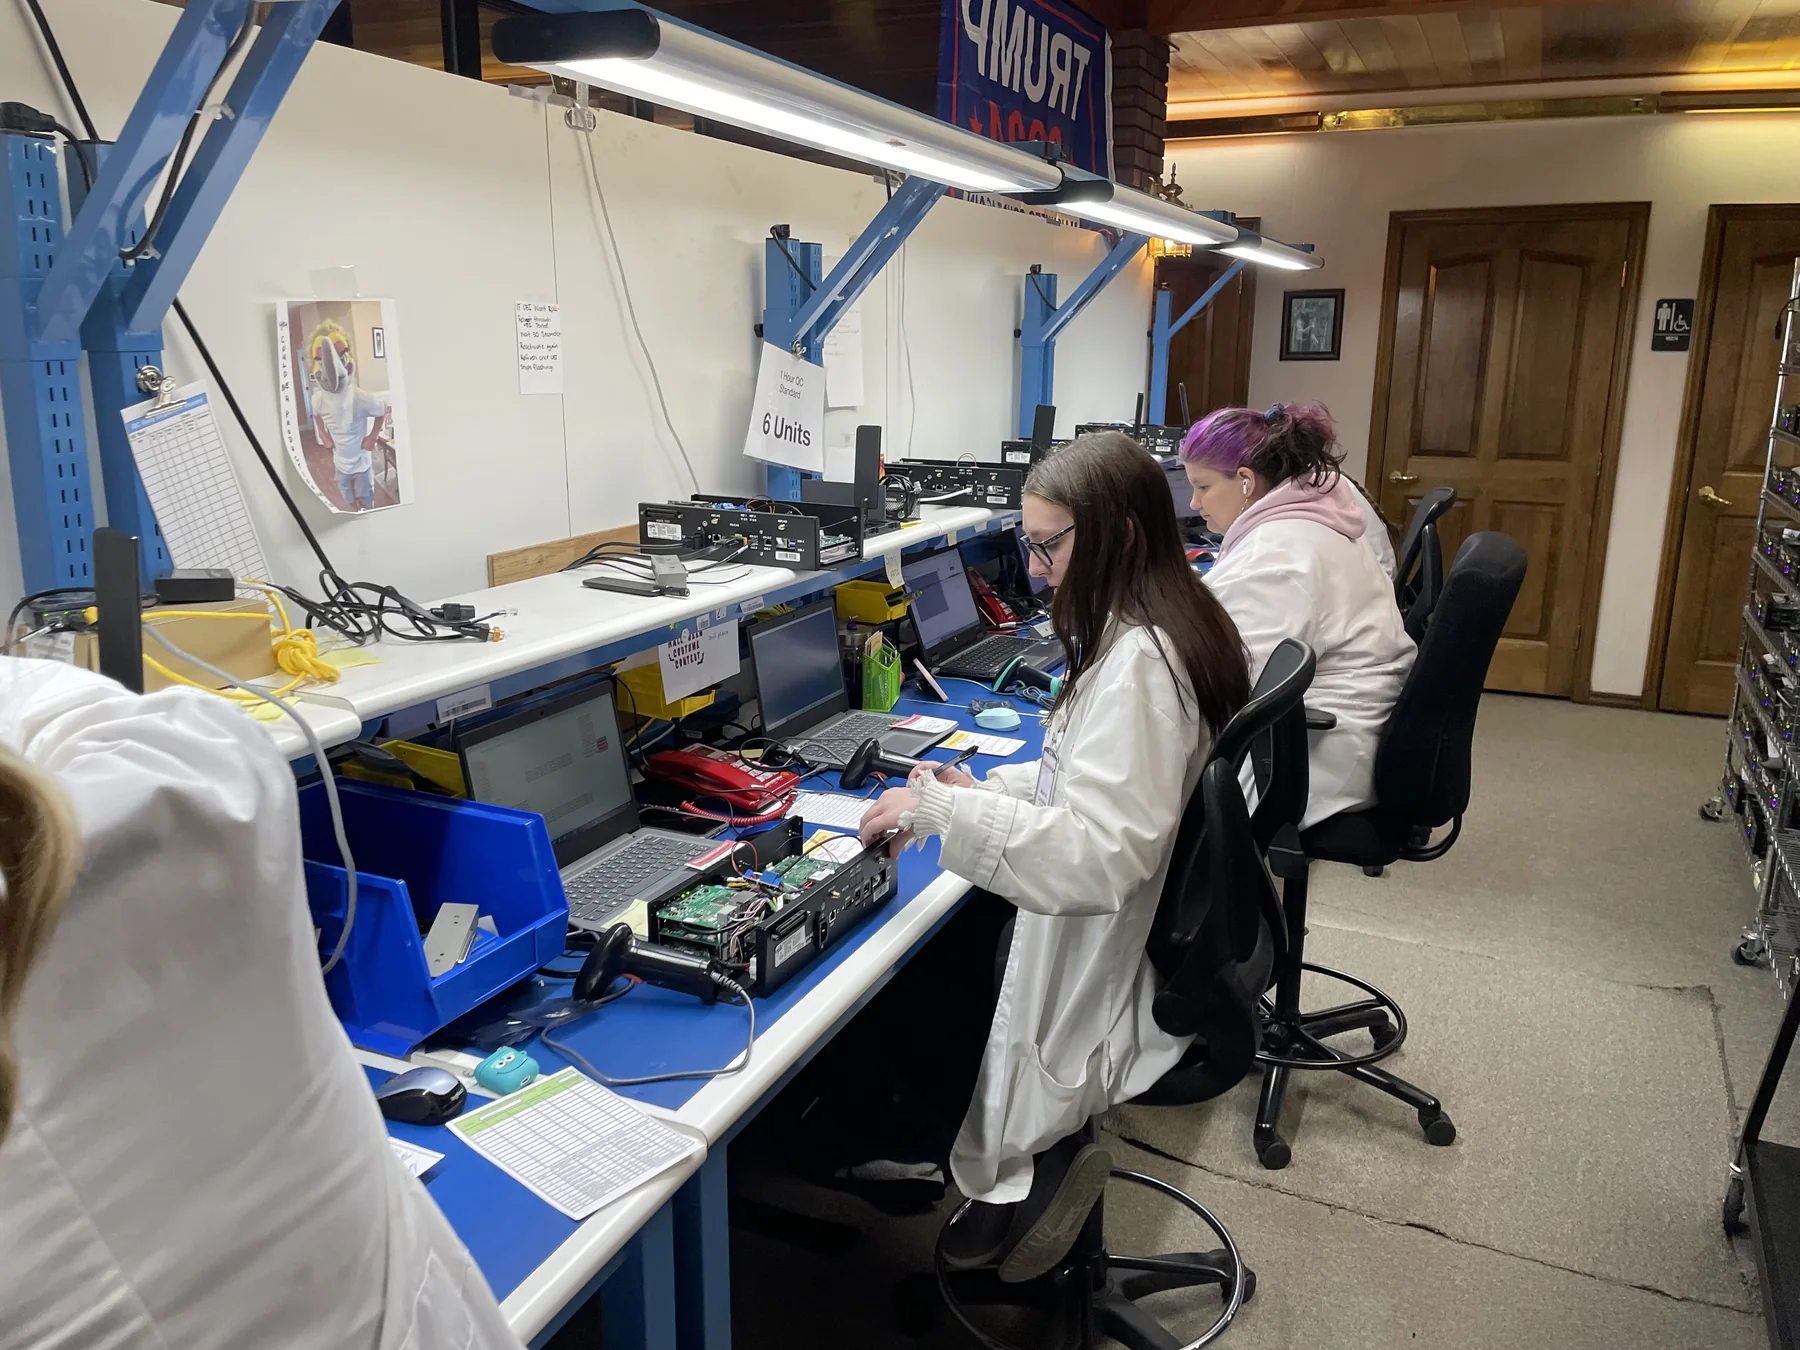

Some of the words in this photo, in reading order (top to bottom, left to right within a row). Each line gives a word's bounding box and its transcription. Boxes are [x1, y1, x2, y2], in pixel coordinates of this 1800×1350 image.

[783, 371, 795, 384] Hour
[795, 376, 804, 387] QC
[779, 384, 801, 399] Standard
[762, 412, 771, 435] 6
[774, 415, 811, 447] Units
[672, 640, 700, 658] COSTUME
[674, 651, 701, 669] CONTEST
